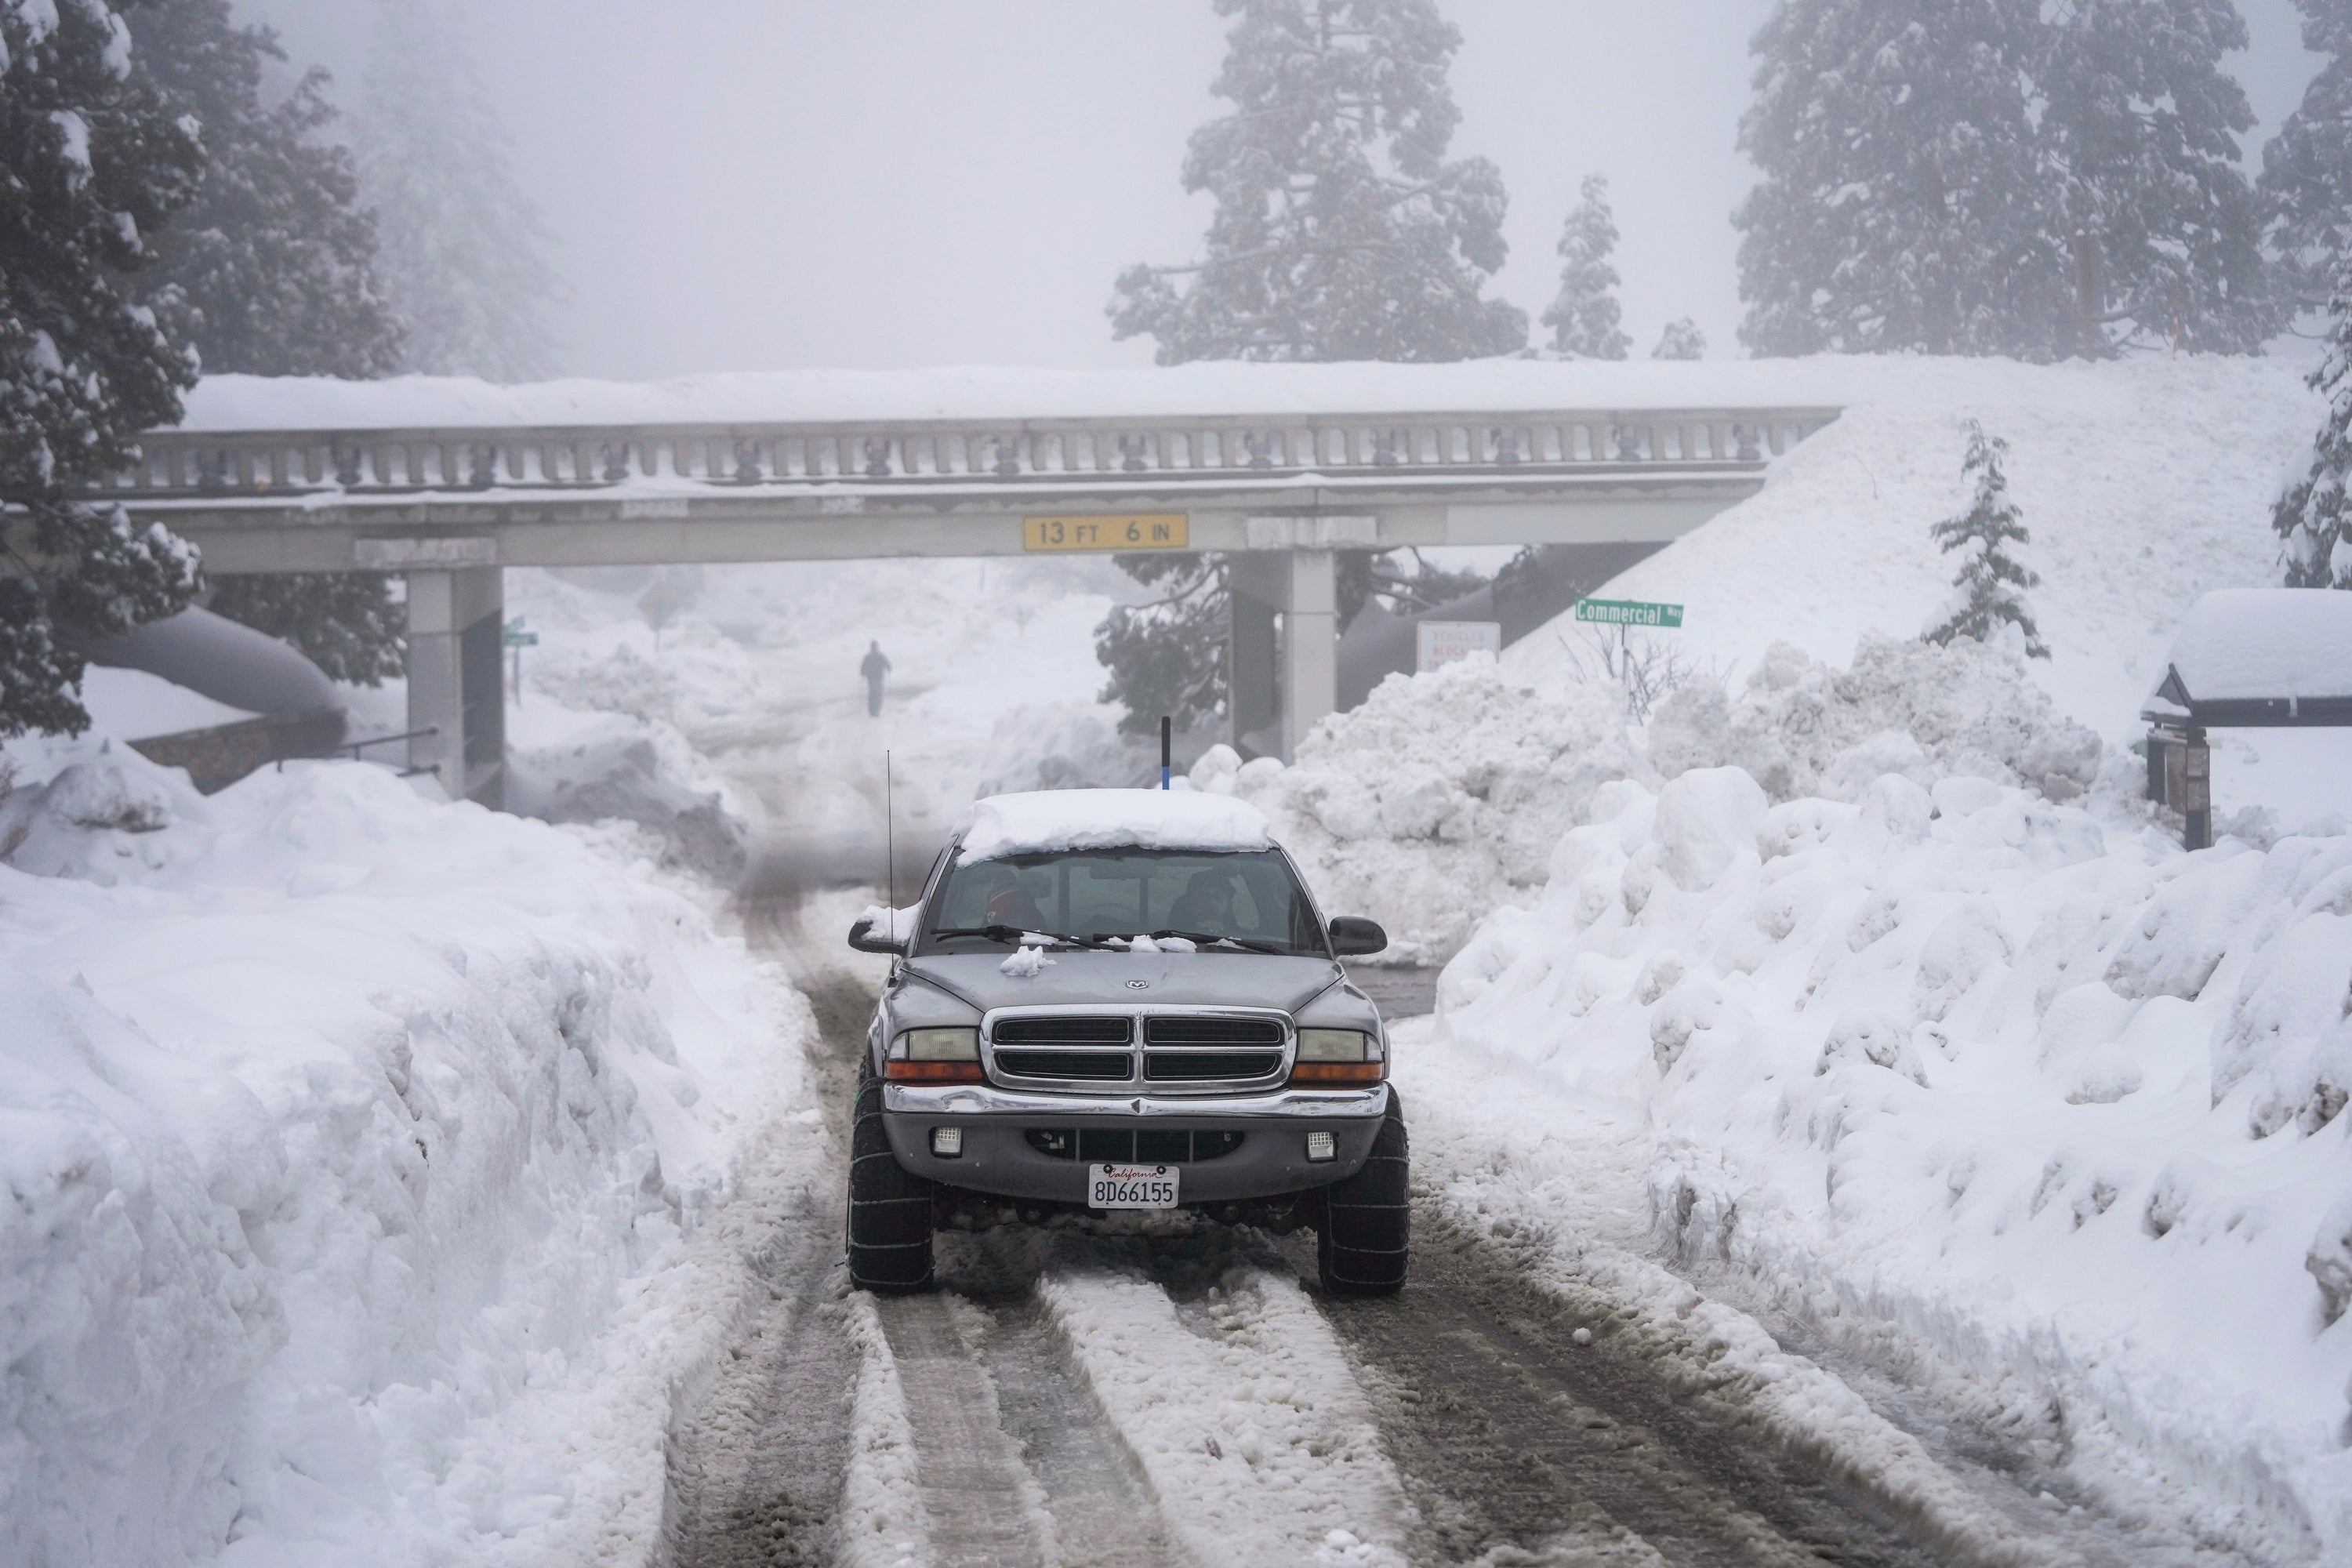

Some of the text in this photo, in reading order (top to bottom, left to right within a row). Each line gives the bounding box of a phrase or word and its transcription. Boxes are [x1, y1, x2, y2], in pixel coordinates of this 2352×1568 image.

[1040, 521, 1170, 543] 13 FT 6 IN
[1577, 599, 1682, 624] Commercial Way
[1109, 1167, 1163, 1181] California
[1094, 1181, 1173, 1203] 8D66155
